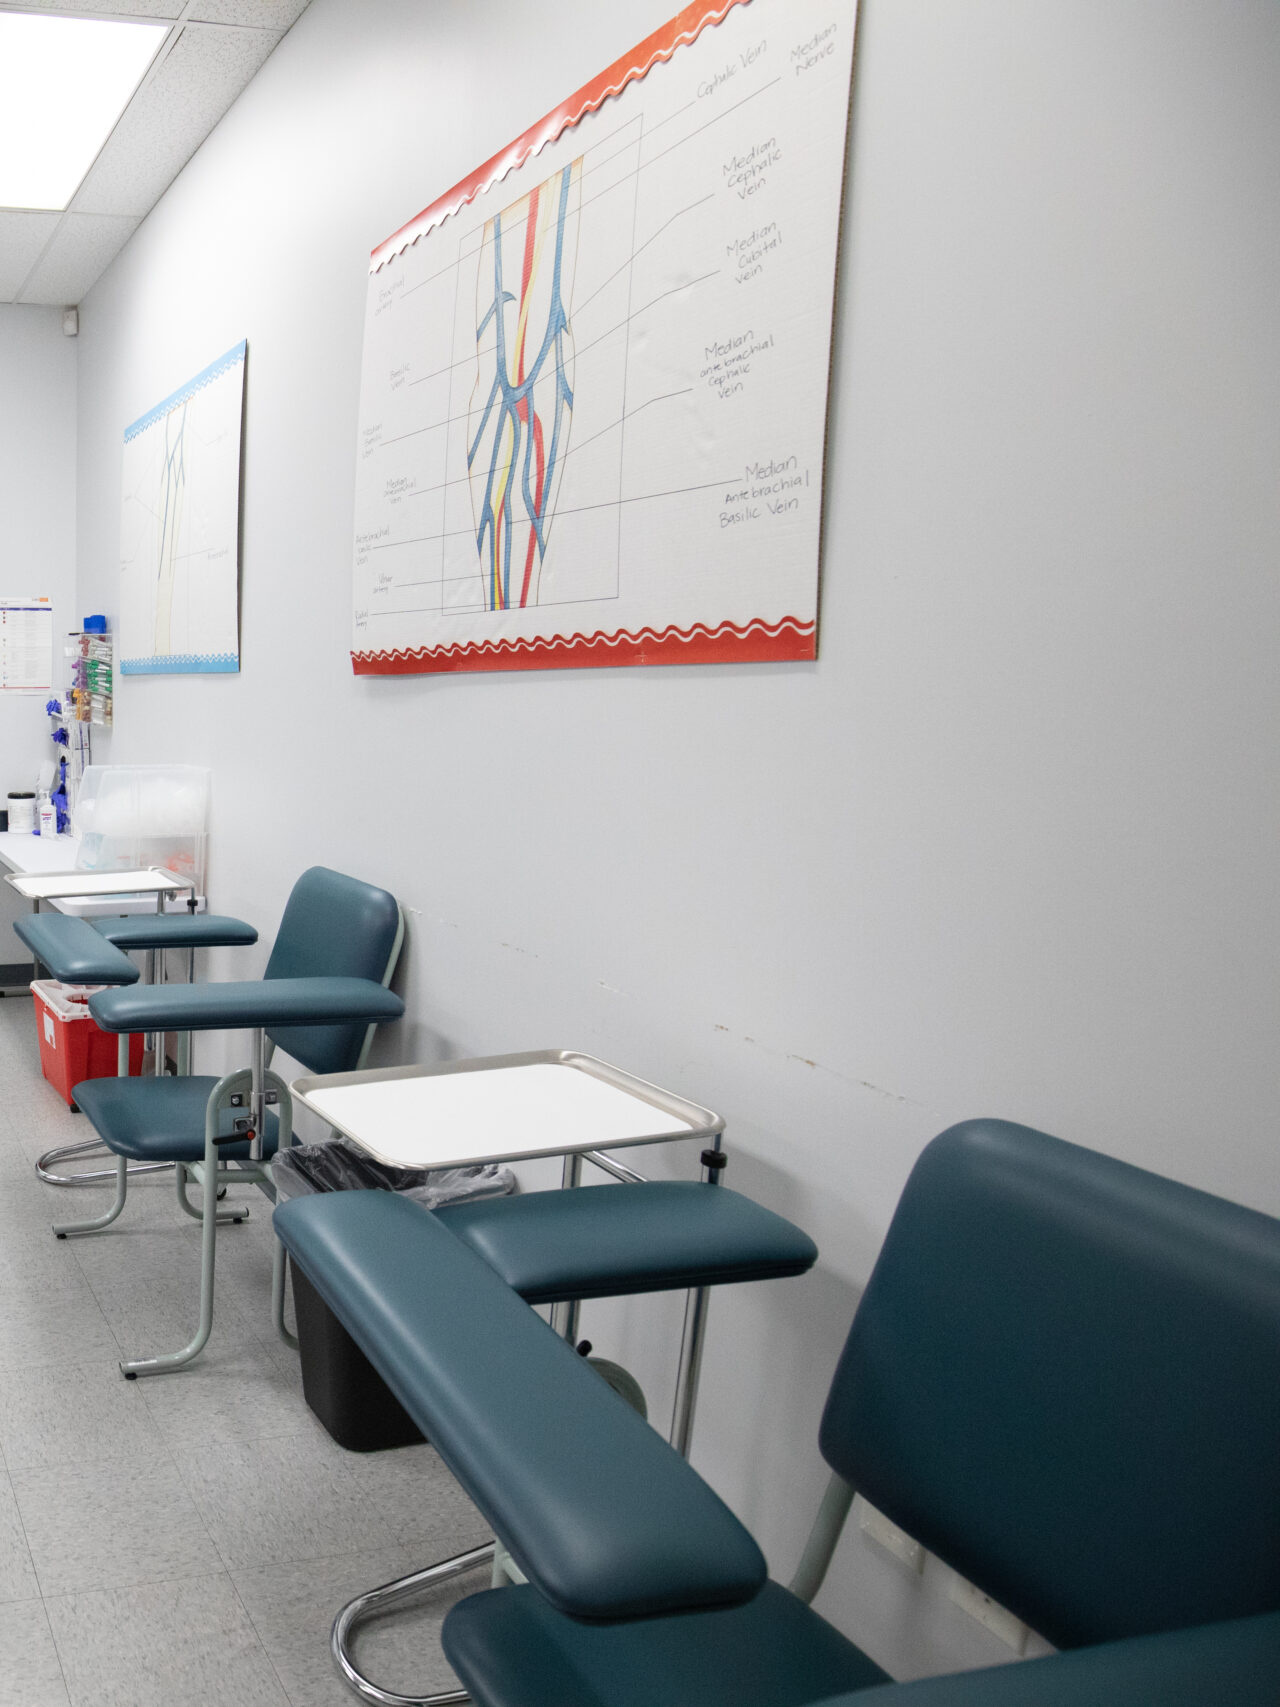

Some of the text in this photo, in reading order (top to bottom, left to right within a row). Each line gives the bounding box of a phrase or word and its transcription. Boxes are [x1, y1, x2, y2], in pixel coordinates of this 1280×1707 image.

[739, 39, 767, 69] Vein
[790, 23, 837, 62] Median
[795, 42, 835, 76] Nerve
[722, 137, 776, 177] Median
[726, 222, 777, 257] Median
[704, 329, 754, 361] Median
[745, 455, 798, 483] Median
[719, 497, 799, 529] Basilic Vein
